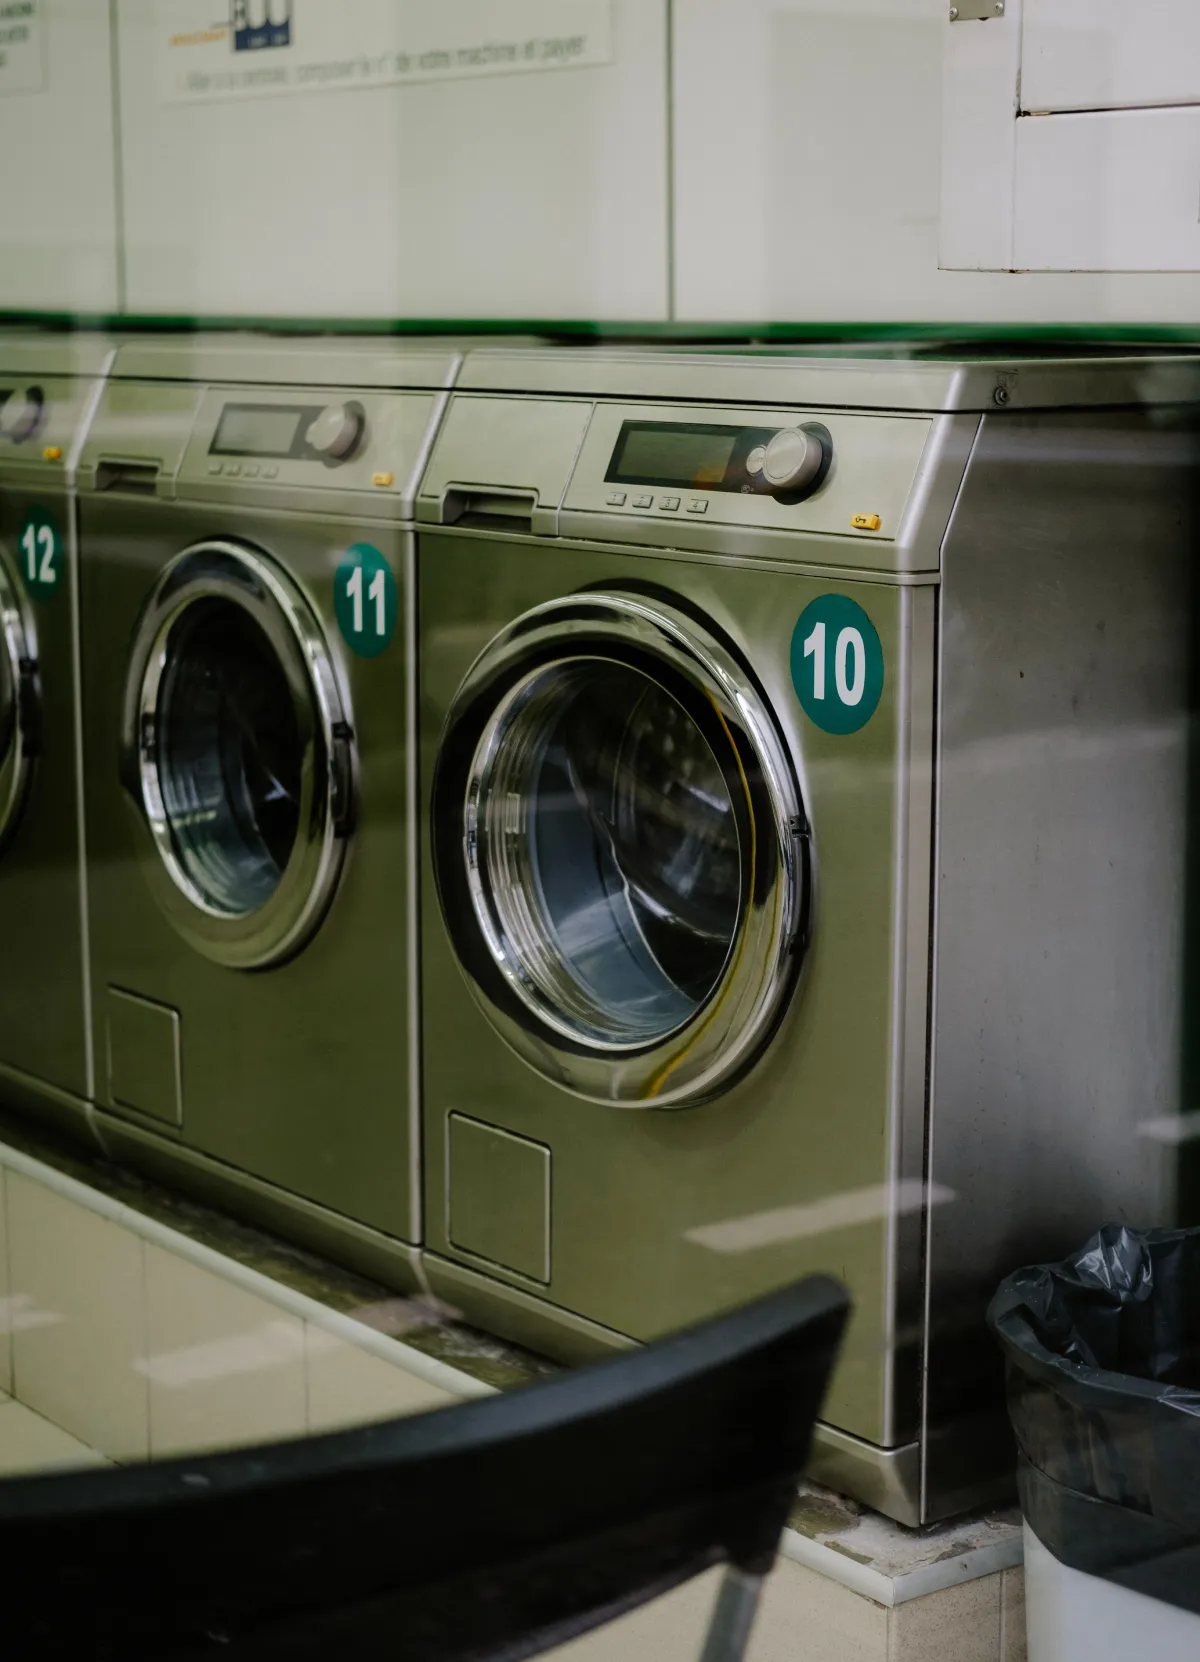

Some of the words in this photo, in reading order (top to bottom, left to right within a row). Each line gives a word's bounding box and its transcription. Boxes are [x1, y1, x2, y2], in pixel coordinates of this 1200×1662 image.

[22, 522, 56, 583] 12
[346, 565, 386, 636] 11
[803, 621, 866, 707] 10
